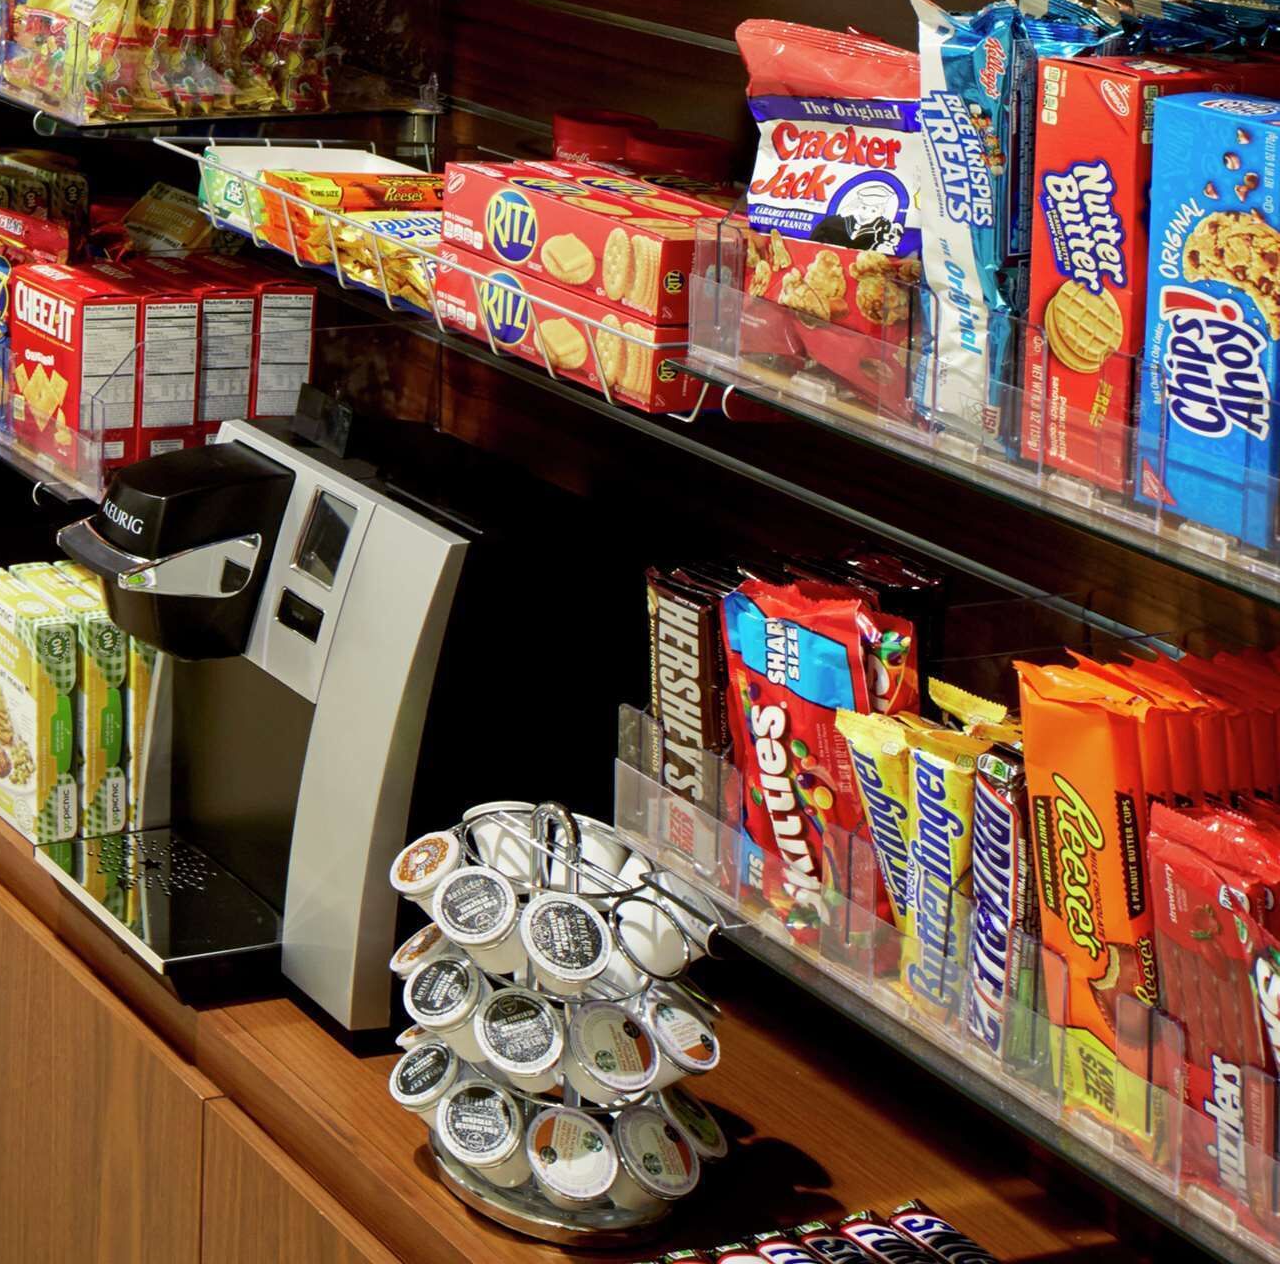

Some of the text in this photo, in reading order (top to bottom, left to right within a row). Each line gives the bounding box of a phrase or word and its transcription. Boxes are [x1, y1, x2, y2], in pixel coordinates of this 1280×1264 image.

[979, 37, 1007, 99] Kellogg's
[1103, 82, 1128, 115] NABISCO
[800, 101, 902, 122] The Original
[771, 121, 902, 170] Cracker
[920, 90, 972, 224] TREATS
[942, 93, 994, 228] RICE KRISPIES
[384, 187, 424, 202] Reese's
[749, 163, 838, 203] Jack
[754, 206, 814, 221] CARAMEL COATED
[490, 194, 537, 249] RITZ
[779, 220, 812, 232] PEANUTS
[1045, 173, 1101, 293] Butter
[1045, 196, 1071, 272] The PEANUT BUTTER
[1053, 237, 1062, 261] Cookie
[1072, 162, 1126, 286] Nutter
[1158, 197, 1206, 280] ORIGINAL
[14, 280, 76, 344] CHEEZ-IT
[479, 277, 529, 331] RITZ
[664, 270, 685, 293] RITZ
[944, 260, 983, 356] Original
[1031, 363, 1043, 380] NET
[1031, 380, 1042, 395] WT
[1168, 313, 1228, 434] Chips
[982, 406, 999, 434] USA
[103, 498, 144, 535] KEURIG
[52, 637, 64, 659] NO
[103, 631, 114, 650] NO
[786, 626, 800, 681] SIZE
[649, 644, 659, 706] CHOCOLATE
[656, 594, 705, 802] HERSHEY'S
[647, 724, 659, 774] ALMONDS
[752, 700, 831, 928] Skittles
[907, 746, 966, 1020] Butterfinger
[1037, 806, 1054, 909] PEANUT BUTTER CUPS
[1052, 771, 1106, 962] Reese's
[1122, 799, 1141, 912] 4 PEANUT BUTTER CUPS
[973, 781, 1013, 998] IRRITABLE
[1093, 875, 1106, 942] CHOCOLATE
[1164, 863, 1178, 925] strawberry
[1135, 935, 1155, 1008] Reese's
[1078, 1046, 1102, 1106] SIZE
[1095, 1059, 1117, 1117] KING
